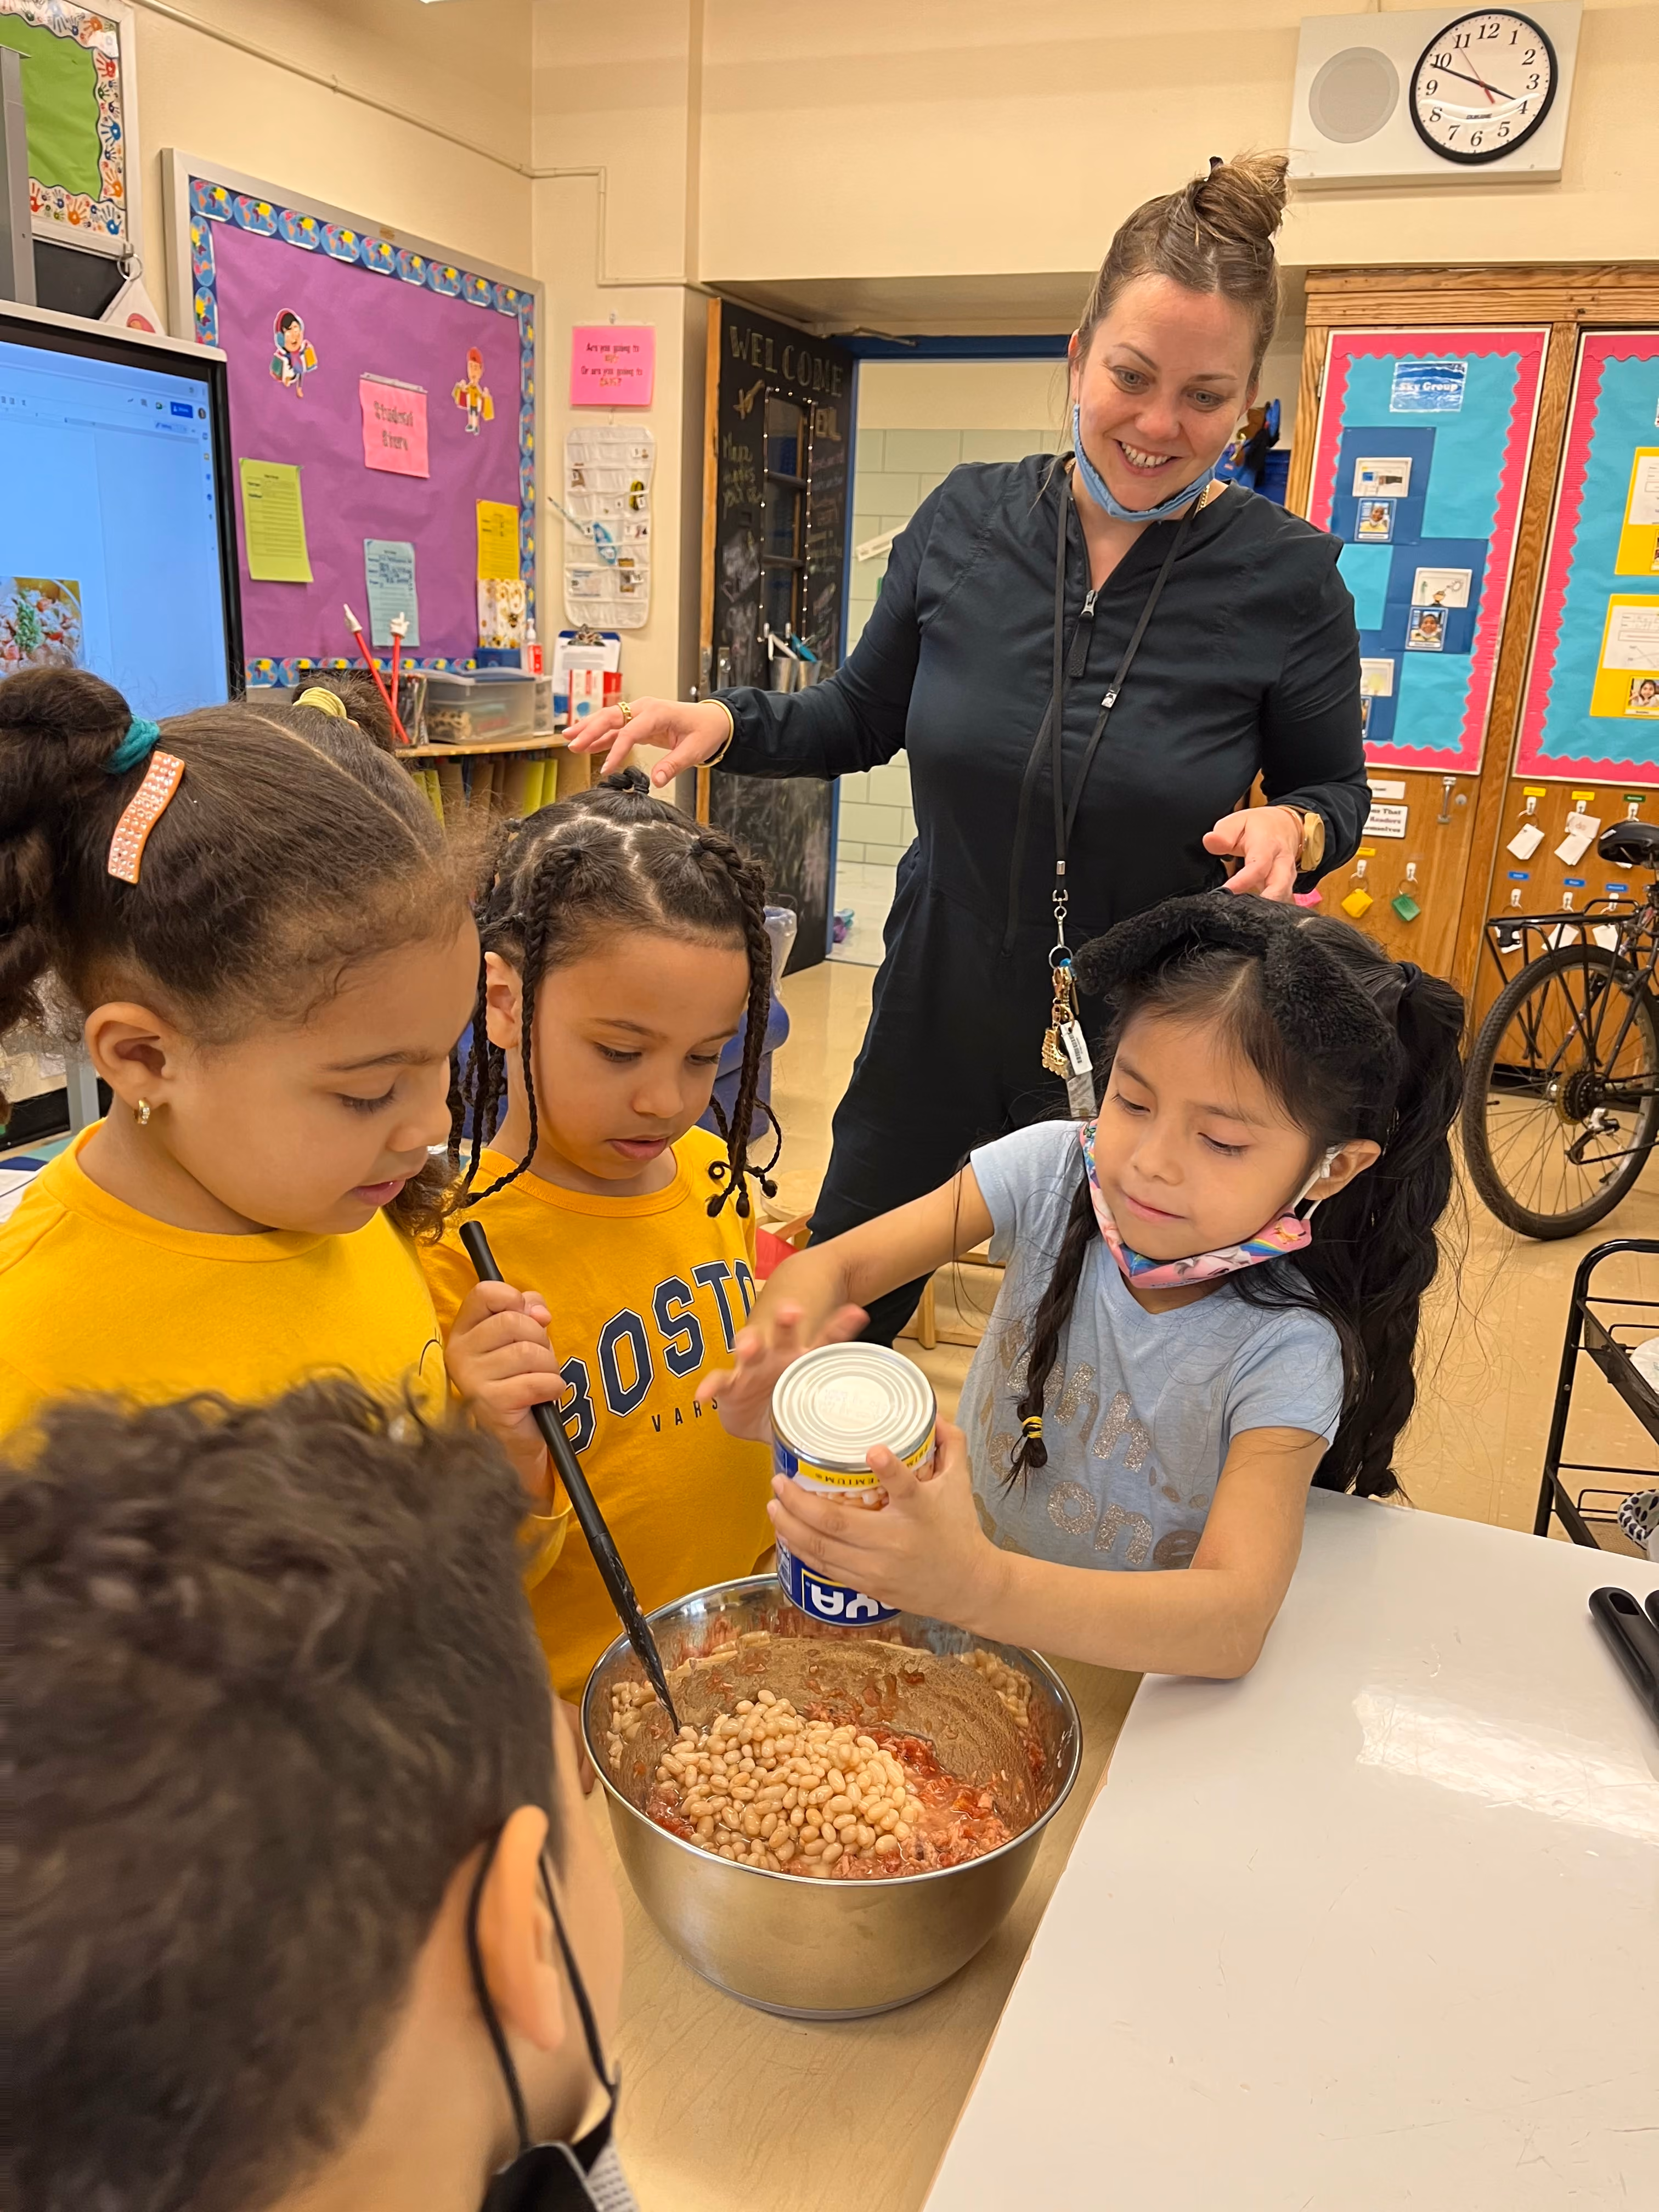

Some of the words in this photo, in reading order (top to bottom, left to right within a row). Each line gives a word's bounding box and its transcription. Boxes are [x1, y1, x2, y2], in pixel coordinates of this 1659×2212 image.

[1477, 22, 1500, 40] 12
[1509, 30, 1519, 45] 1
[1453, 33, 1471, 49] 11
[1432, 53, 1452, 69] 10
[1522, 49, 1536, 65] 2
[1426, 80, 1438, 95] 9
[1526, 74, 1540, 90] 3
[1429, 106, 1442, 122] 8
[1517, 99, 1528, 115] 4
[1448, 125, 1460, 140] 7
[1497, 121, 1510, 137] 5
[1470, 131, 1483, 146] 6
[729, 325, 843, 398] WELCOME
[1400, 382, 1420, 393] Sky
[1422, 381, 1458, 392] Group
[824, 1475, 880, 1486] EMIUM
[811, 1583, 895, 1618] YA
